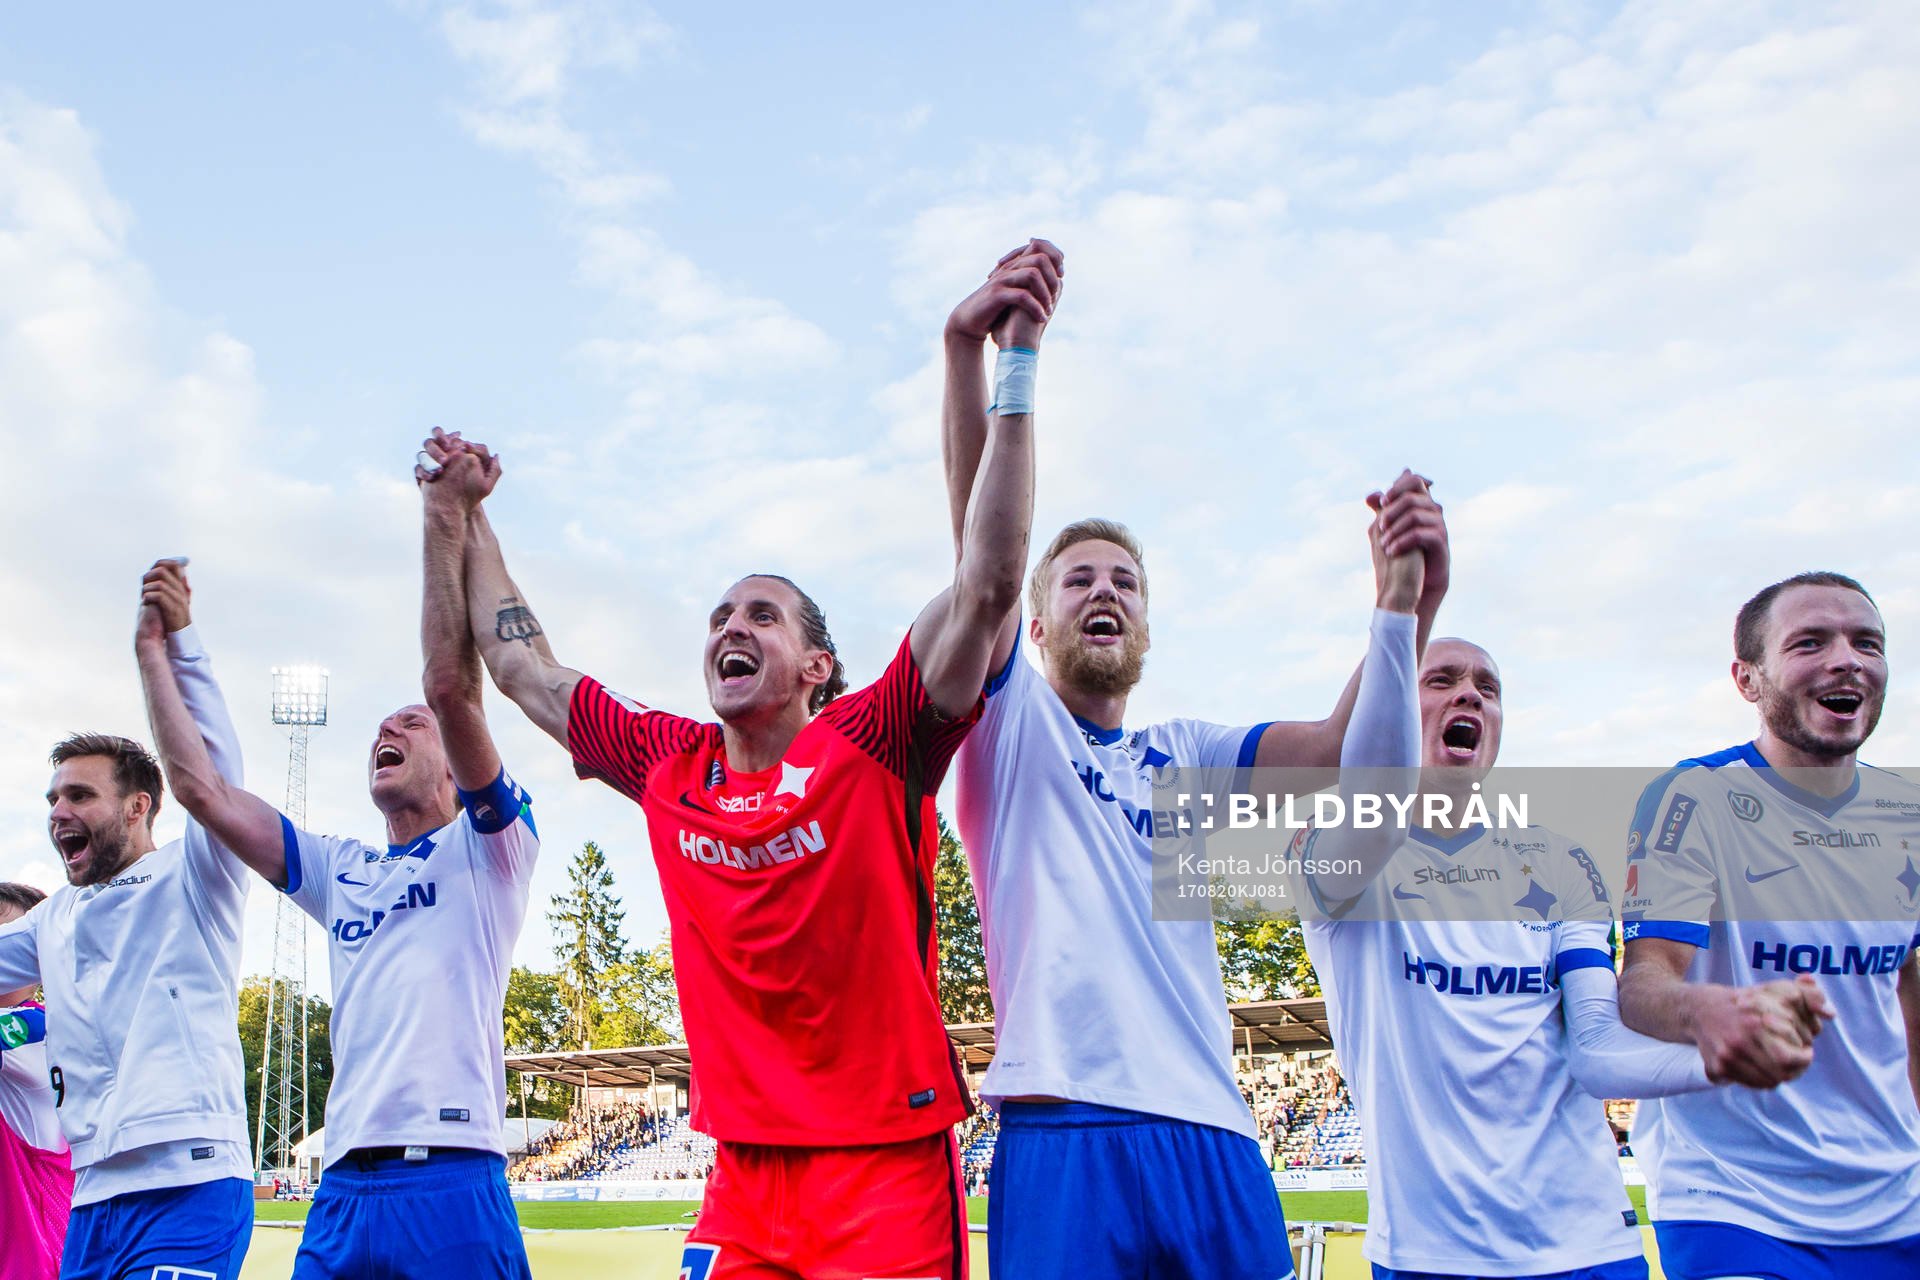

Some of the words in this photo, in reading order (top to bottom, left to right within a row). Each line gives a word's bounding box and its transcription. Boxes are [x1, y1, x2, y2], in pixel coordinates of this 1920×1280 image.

[1071, 760, 1194, 838] HOMEN
[679, 820, 827, 871] HOLMEN
[1632, 899, 1653, 907] SPEL
[50, 1066, 65, 1108] 9
